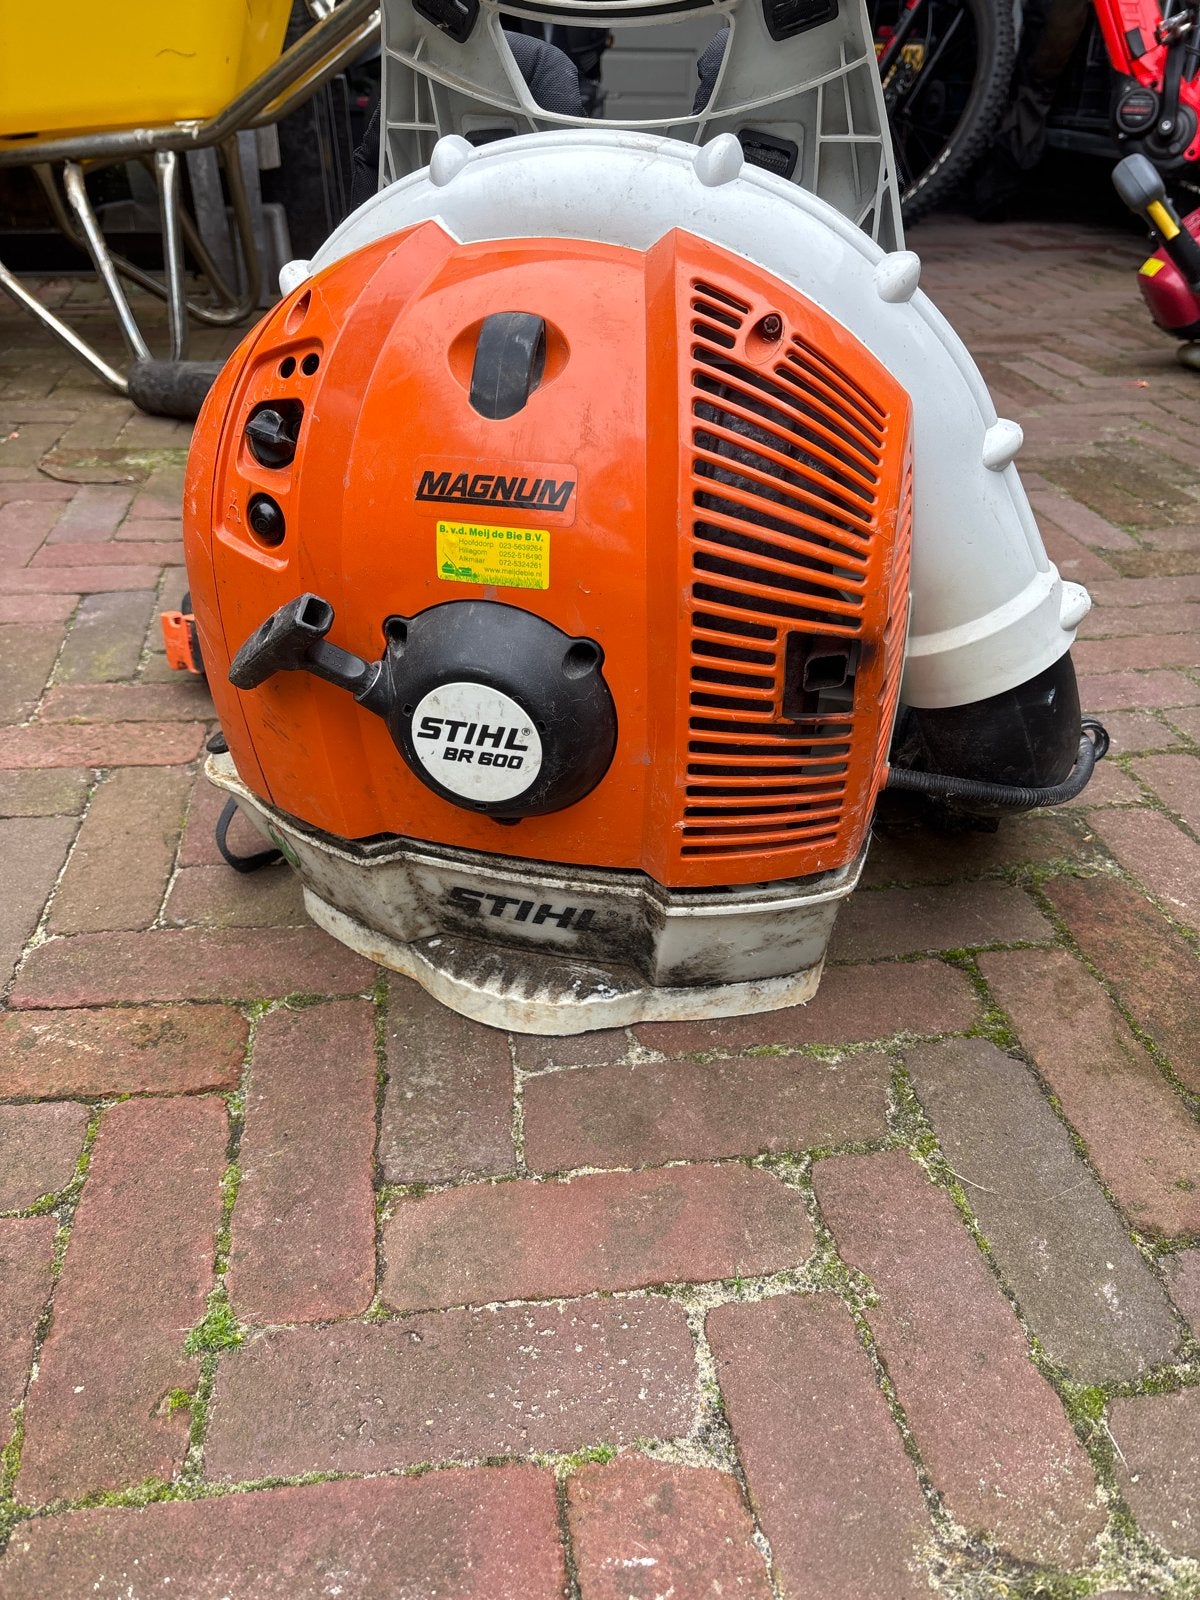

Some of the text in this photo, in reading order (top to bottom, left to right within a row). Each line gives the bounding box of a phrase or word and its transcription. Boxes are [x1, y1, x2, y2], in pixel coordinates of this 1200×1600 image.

[416, 470, 576, 510] MAGNUM
[440, 525, 544, 542] B. v.d. Meij de Bie B.V.
[442, 746, 524, 770] BR 600
